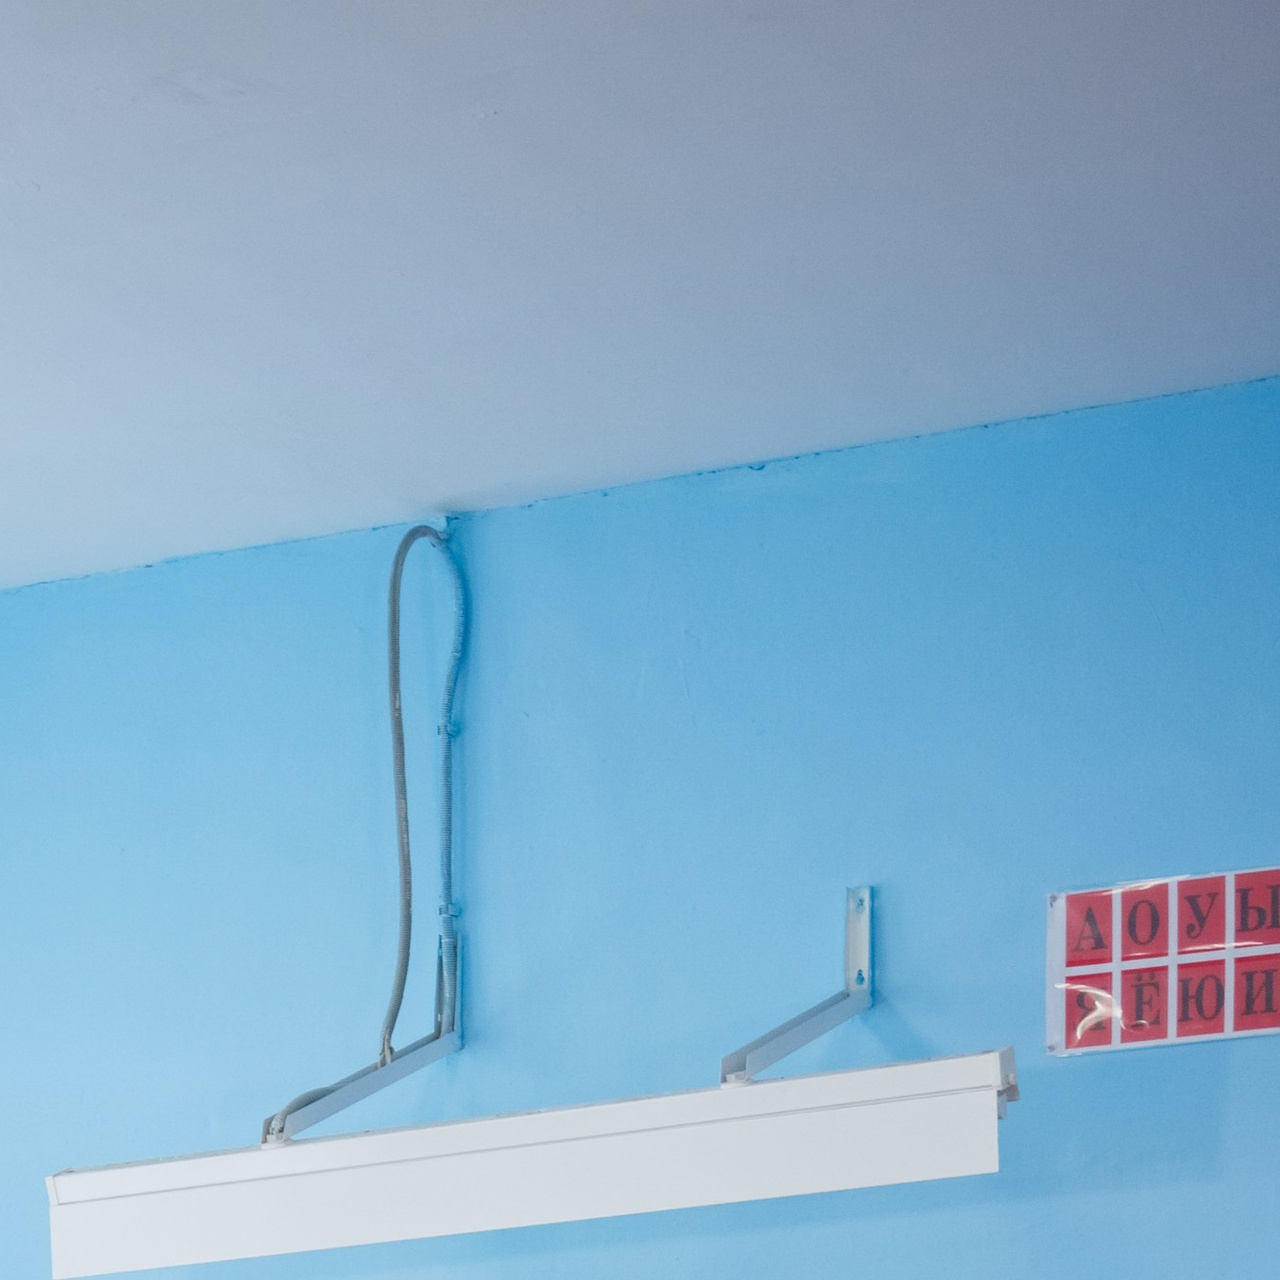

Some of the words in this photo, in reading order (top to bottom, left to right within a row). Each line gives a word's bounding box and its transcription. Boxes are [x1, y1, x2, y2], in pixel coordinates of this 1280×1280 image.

[1073, 906, 1108, 952] А
[1127, 899, 1161, 946] О
[1184, 891, 1219, 940] У
[1178, 973, 1226, 1023] Ю
